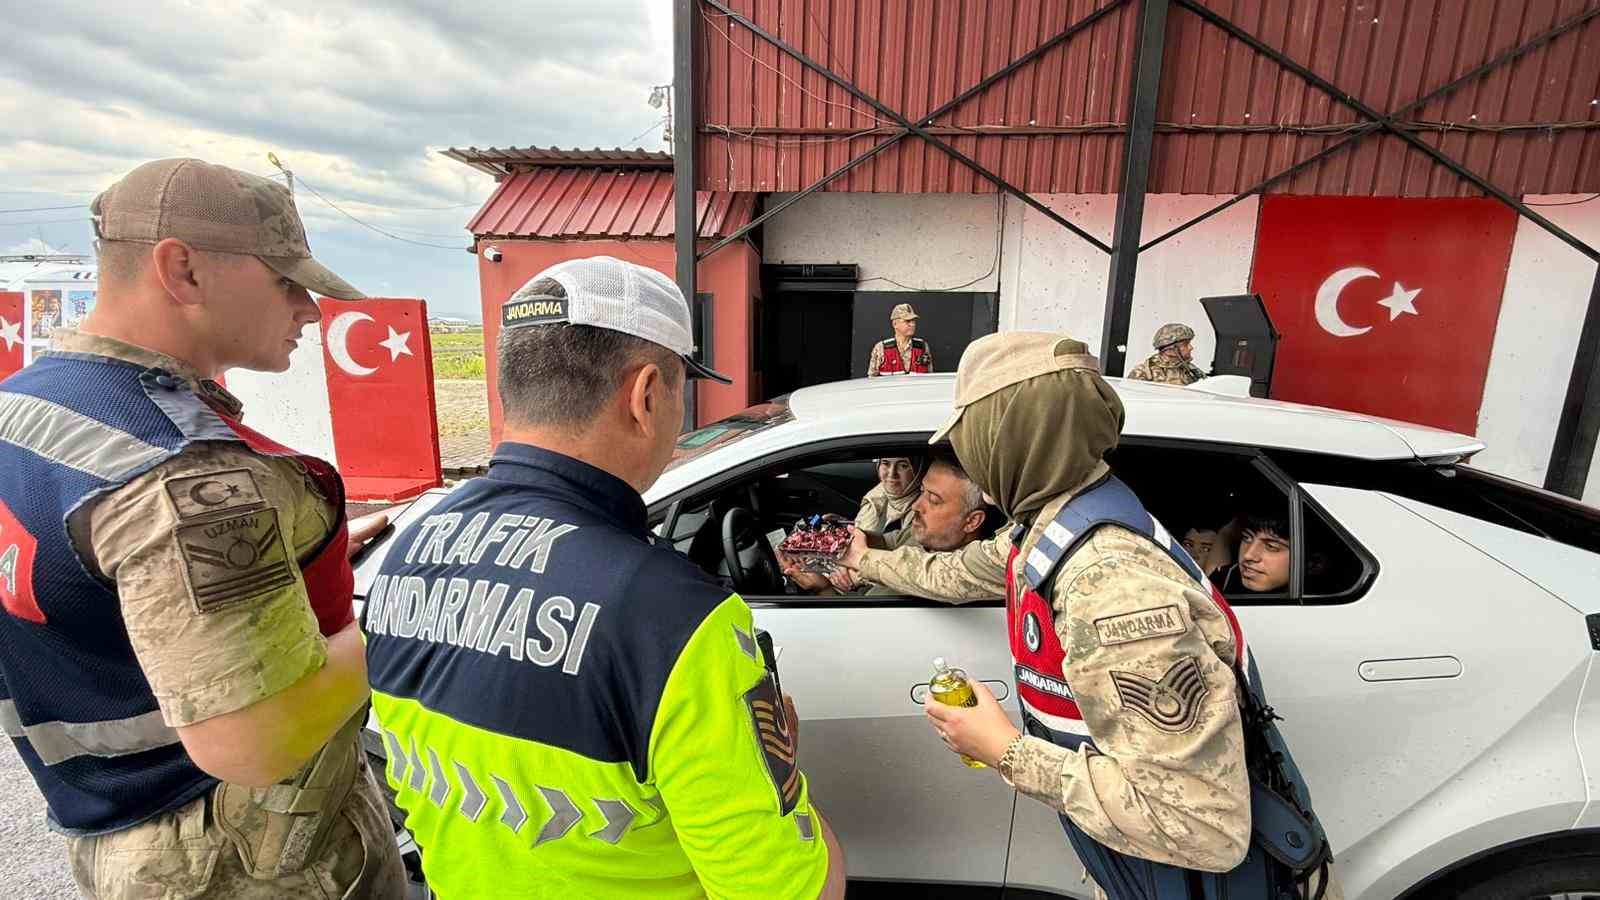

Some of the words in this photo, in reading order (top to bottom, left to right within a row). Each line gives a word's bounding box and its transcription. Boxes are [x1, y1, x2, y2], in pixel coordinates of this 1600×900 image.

[506, 302, 562, 320] JANDARMA
[203, 517, 259, 539] UZMAN
[365, 574, 600, 676] ANDARMASI
[1104, 612, 1176, 638] JANDARMA
[1018, 668, 1073, 698] JANDARMA
